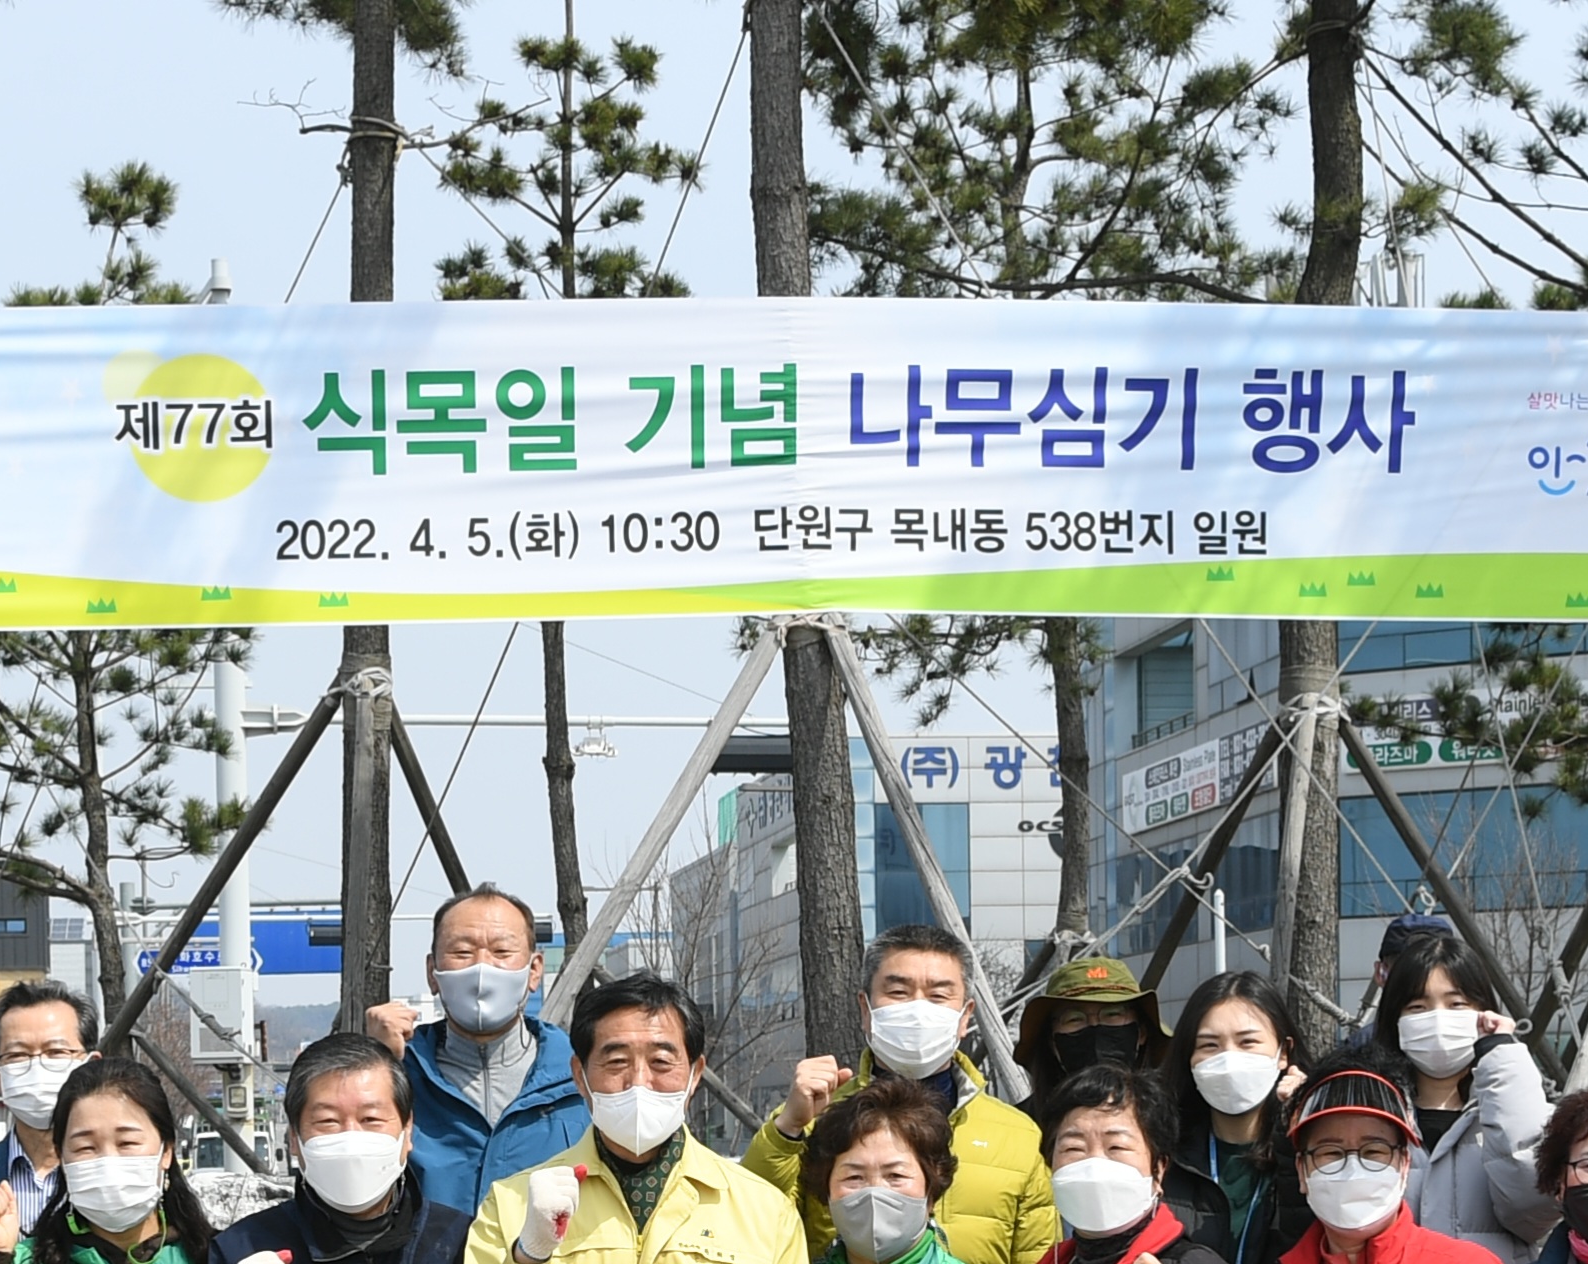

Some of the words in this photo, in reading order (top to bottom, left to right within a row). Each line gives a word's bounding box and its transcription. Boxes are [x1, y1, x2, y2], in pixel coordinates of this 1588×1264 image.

[115, 400, 273, 450] 제77회
[302, 366, 578, 475] 식목일
[625, 361, 798, 469] 기념
[850, 364, 1200, 472] 나무심기
[1242, 369, 1416, 474] 행사
[276, 518, 390, 561] 2022.
[409, 518, 447, 559] 4.
[467, 510, 580, 561] 5.(화)
[601, 510, 721, 553] 10:30
[754, 505, 873, 552] 단원구
[890, 507, 1009, 554] 목내동
[1024, 507, 1177, 554] 538번지
[1192, 507, 1269, 555] 일원
[900, 746, 960, 789] (주)
[173, 951, 221, 963] 화호수
